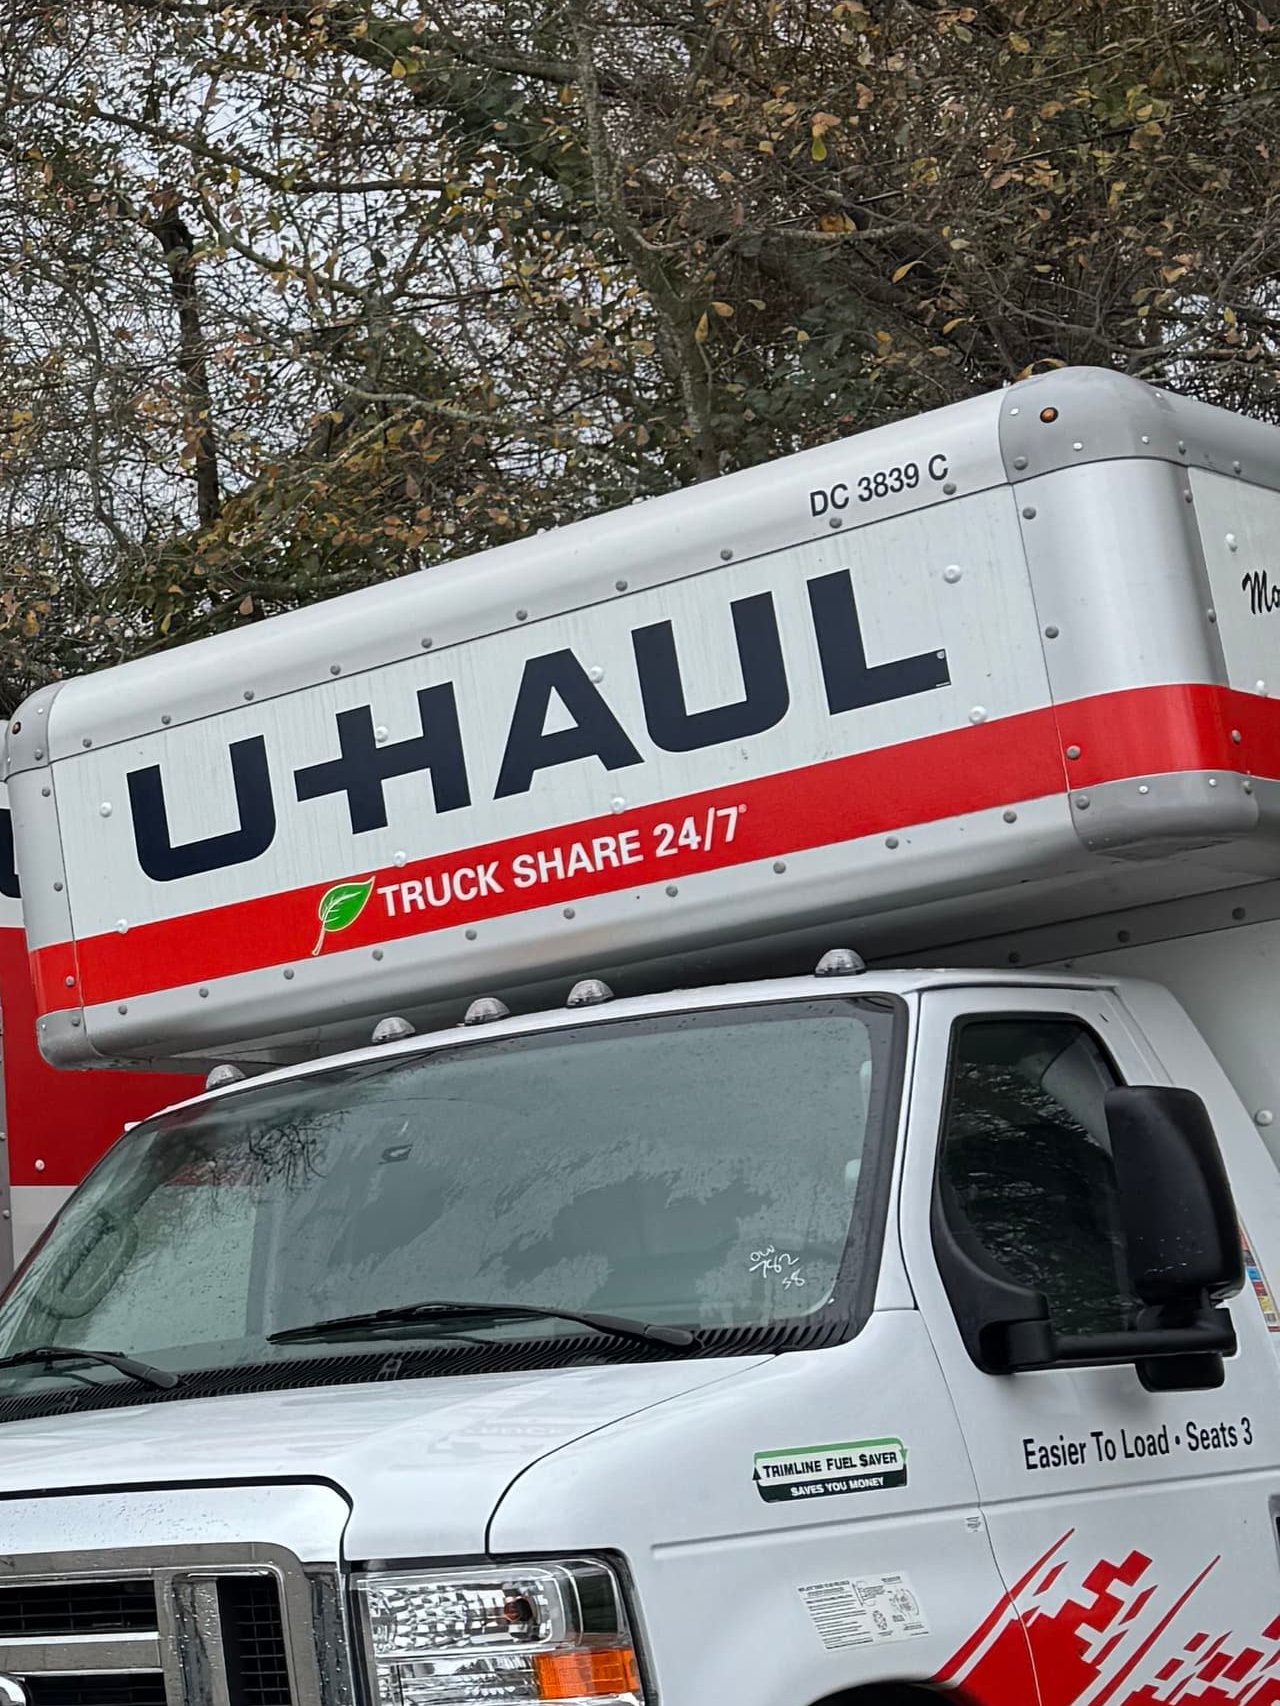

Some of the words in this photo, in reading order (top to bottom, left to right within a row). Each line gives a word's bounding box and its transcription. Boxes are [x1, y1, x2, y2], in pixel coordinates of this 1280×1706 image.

[810, 484, 849, 517] DC
[858, 463, 919, 501] 3839
[928, 454, 949, 480] C
[377, 861, 504, 917] TRUCK
[512, 829, 644, 888] SHARE
[653, 805, 738, 857] 24/7
[762, 1460, 822, 1478] TRIMLINE
[825, 1456, 857, 1471] FUEL
[859, 1451, 897, 1467] SAVER
[1023, 1435, 1086, 1470] Easier
[1090, 1431, 1116, 1461] To
[1121, 1424, 1170, 1459] Load
[1186, 1421, 1238, 1451] Seats
[1241, 1417, 1253, 1445] 3
[790, 1484, 824, 1496] SAVES
[825, 1481, 847, 1492] YOU
[849, 1477, 884, 1489] MONEY
